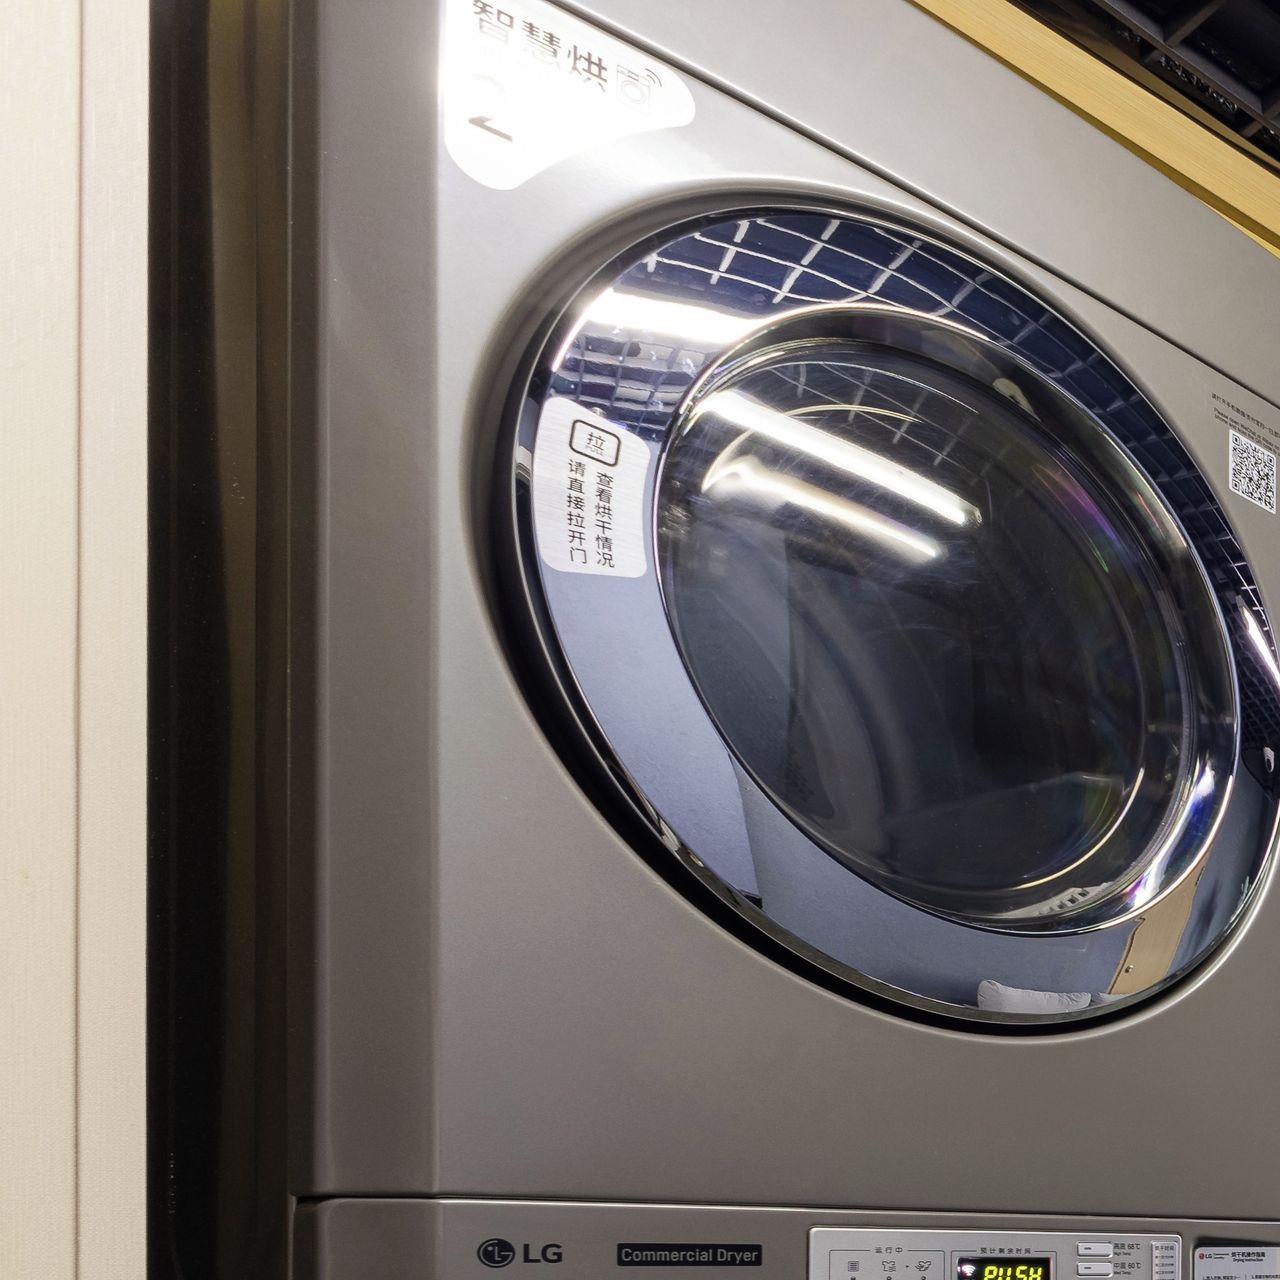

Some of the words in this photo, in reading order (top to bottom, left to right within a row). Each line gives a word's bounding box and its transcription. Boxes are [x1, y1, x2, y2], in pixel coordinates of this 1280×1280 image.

[586, 432, 605, 451] 拉
[567, 459, 587, 564] 请直接拉开门
[595, 472, 615, 568] 查看烘干情况
[523, 1244, 562, 1263] LG
[621, 1248, 712, 1262] Commercial
[717, 1249, 758, 1264] Dryer
